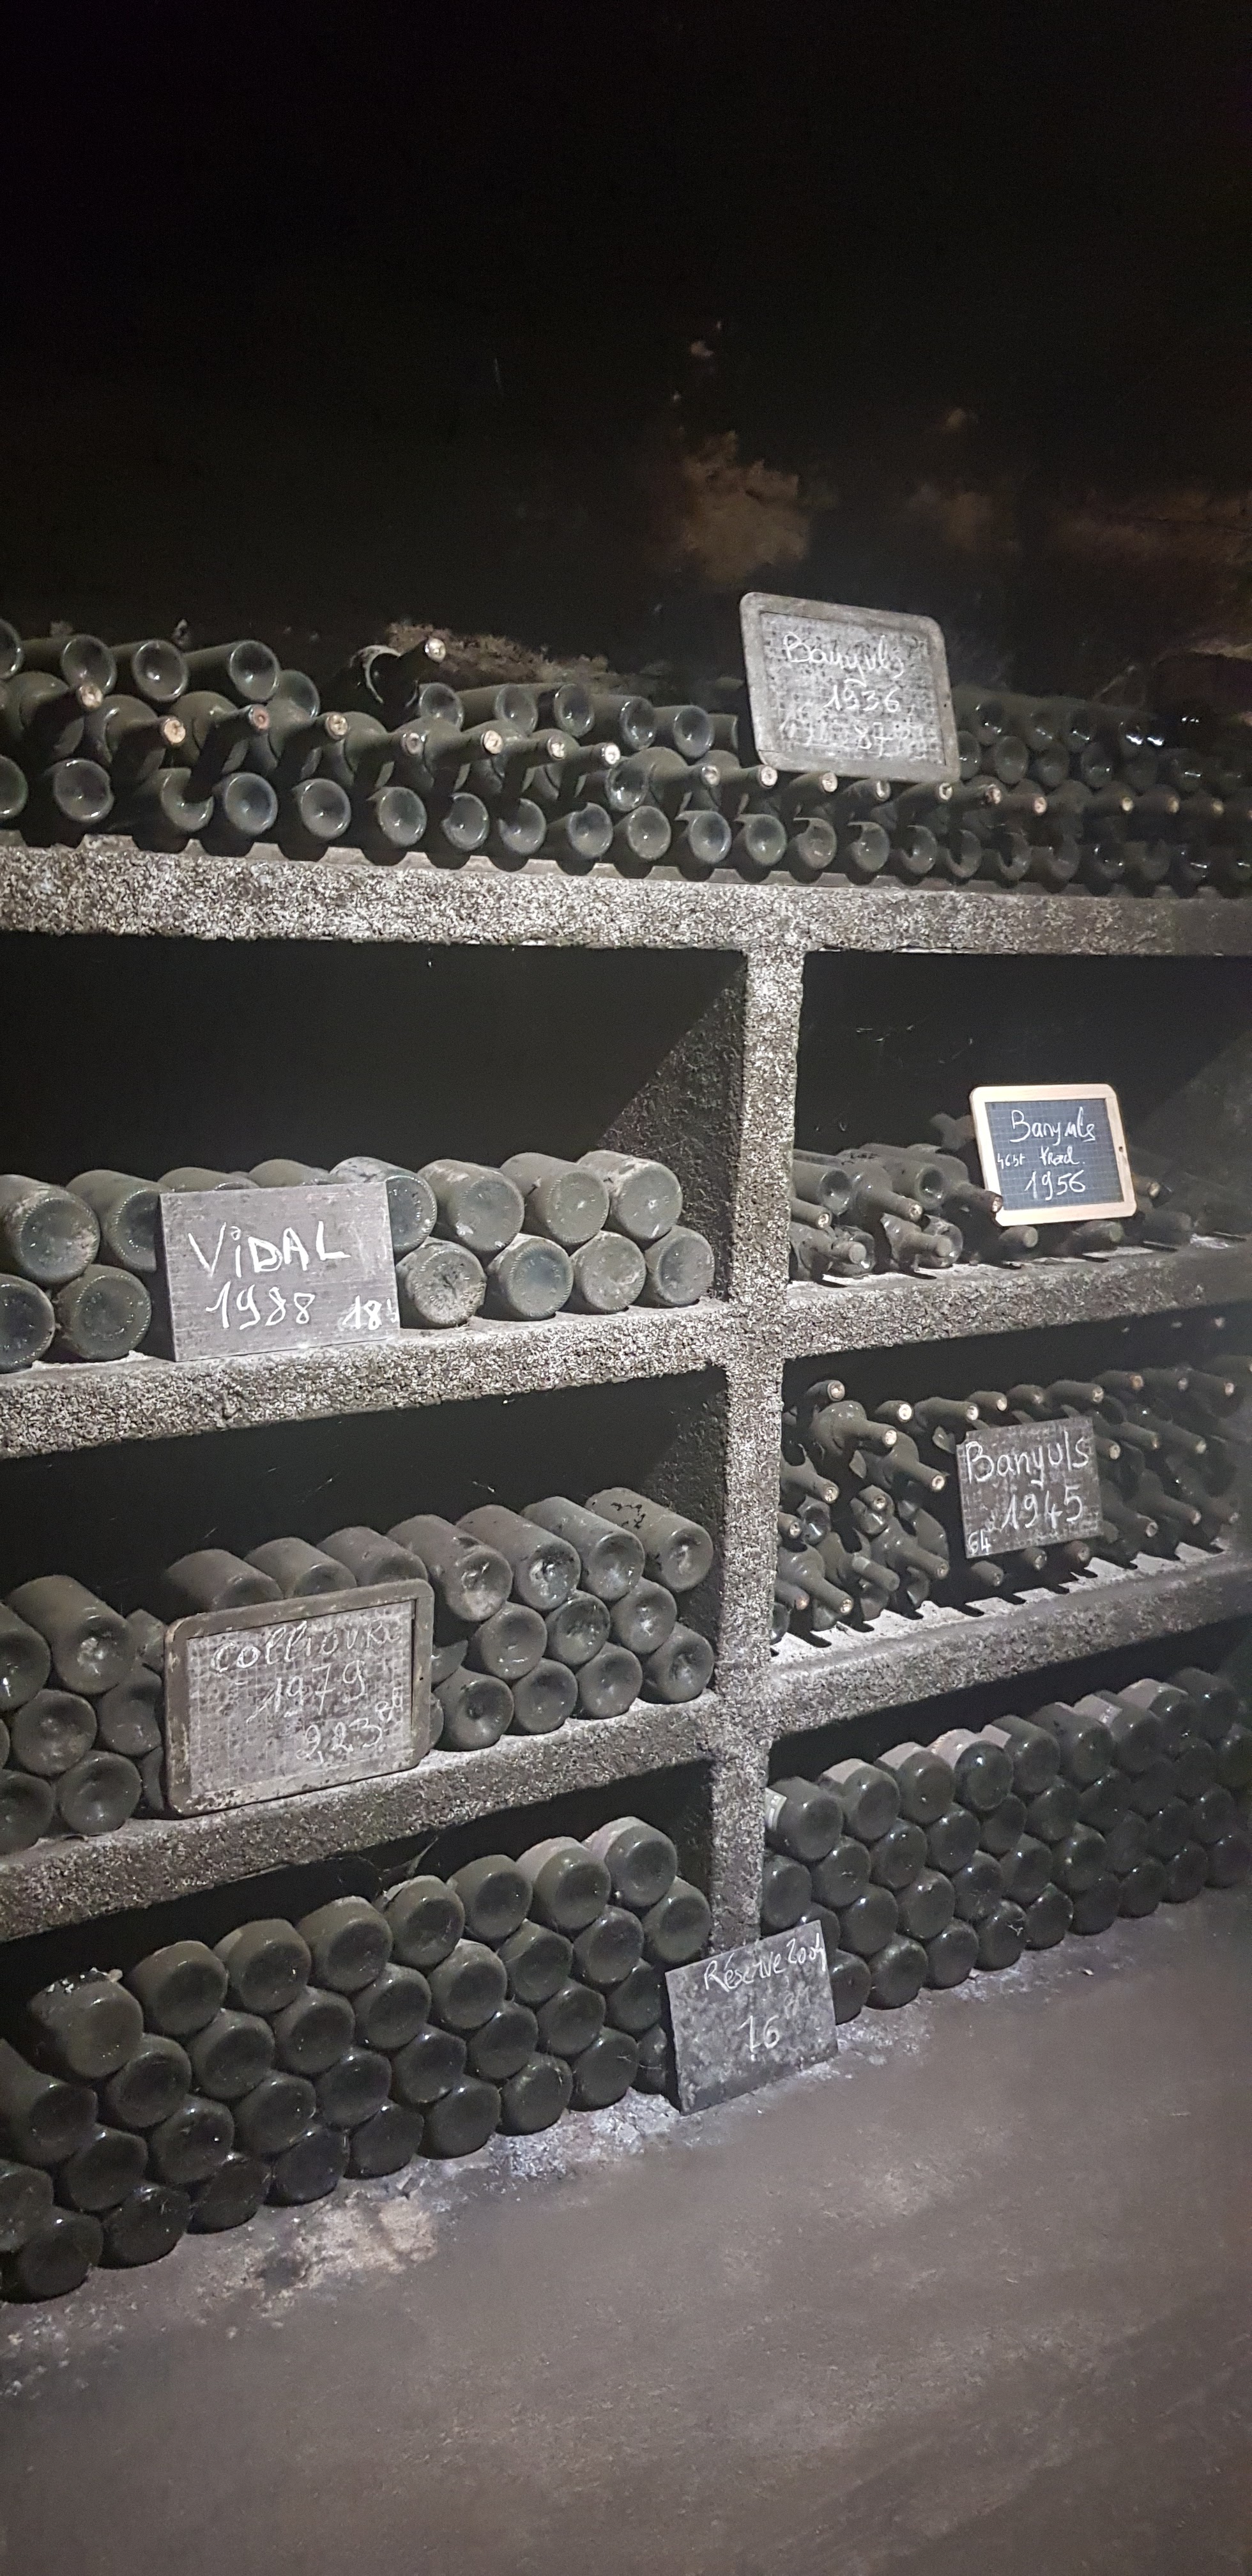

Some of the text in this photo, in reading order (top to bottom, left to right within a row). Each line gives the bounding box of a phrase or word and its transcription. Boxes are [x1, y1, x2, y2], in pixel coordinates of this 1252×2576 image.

[1009, 1106, 1096, 1146] Banyuls
[1024, 1170, 1086, 1200] 1956
[206, 1280, 316, 1331] 1988
[965, 1430, 1090, 1491] Banyuls
[1002, 1485, 1083, 1530] 1945
[246, 1660, 367, 1722] 1979
[737, 2015, 780, 2053] 16
